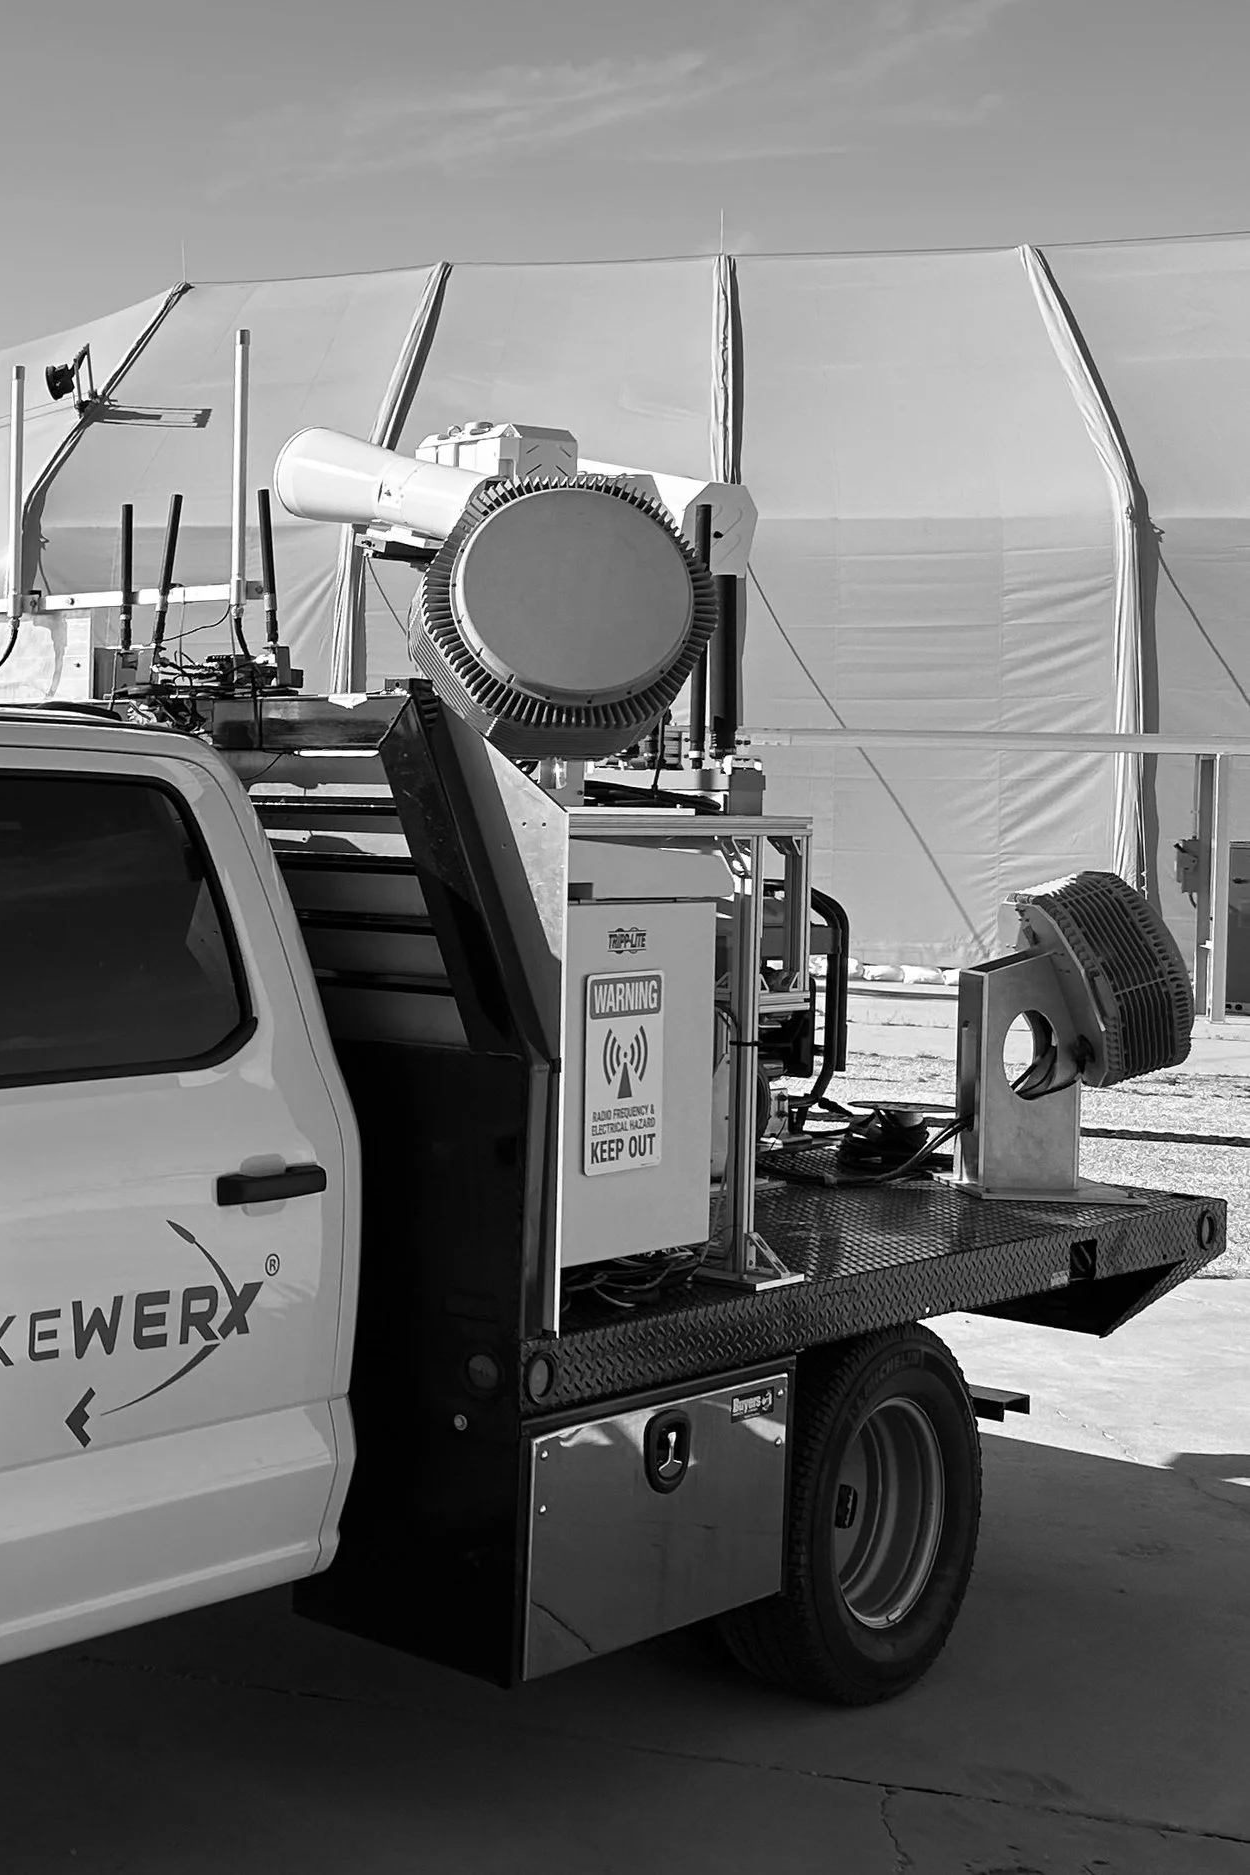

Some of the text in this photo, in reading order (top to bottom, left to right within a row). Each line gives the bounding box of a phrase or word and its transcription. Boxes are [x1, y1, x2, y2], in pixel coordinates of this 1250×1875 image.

[594, 980, 658, 1013] WARNING
[592, 1103, 655, 1122] RADIO FREQUENCY &
[592, 1117, 656, 1136] ELECTRICAL HAZARD
[591, 1133, 656, 1164] KEEP OUT
